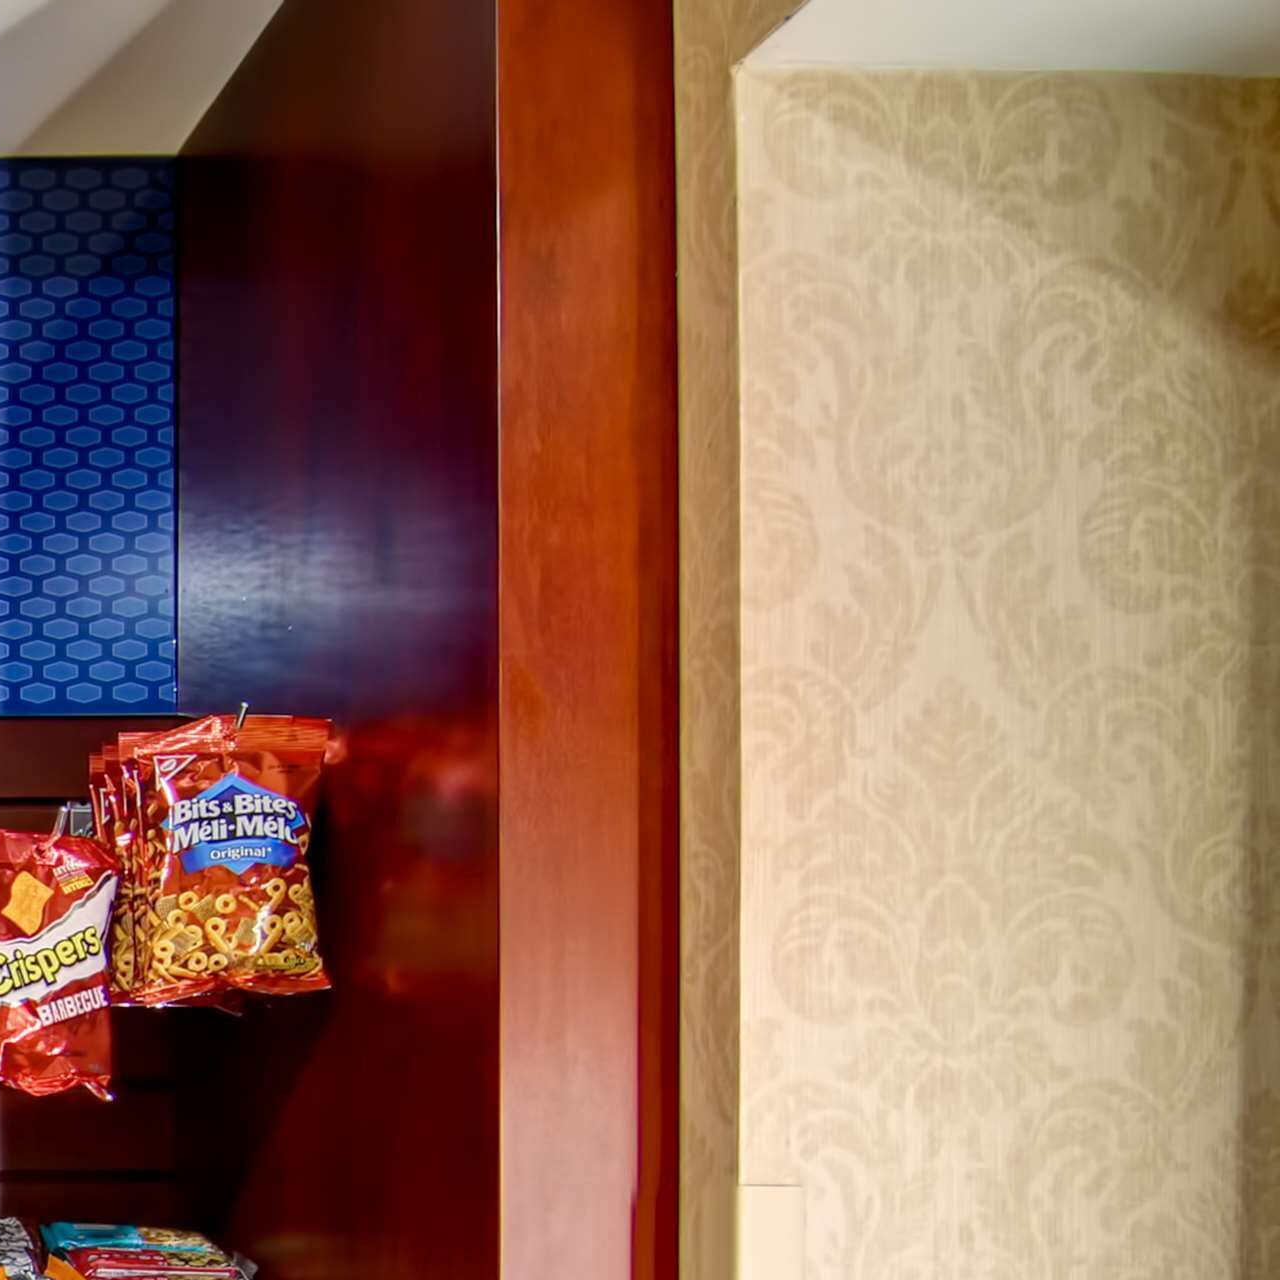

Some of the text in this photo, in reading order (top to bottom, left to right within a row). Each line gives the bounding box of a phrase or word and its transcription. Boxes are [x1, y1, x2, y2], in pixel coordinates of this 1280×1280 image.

[173, 797, 221, 825] Bits
[234, 793, 298, 820] Bites
[37, 985, 108, 1026] BARBECUE
